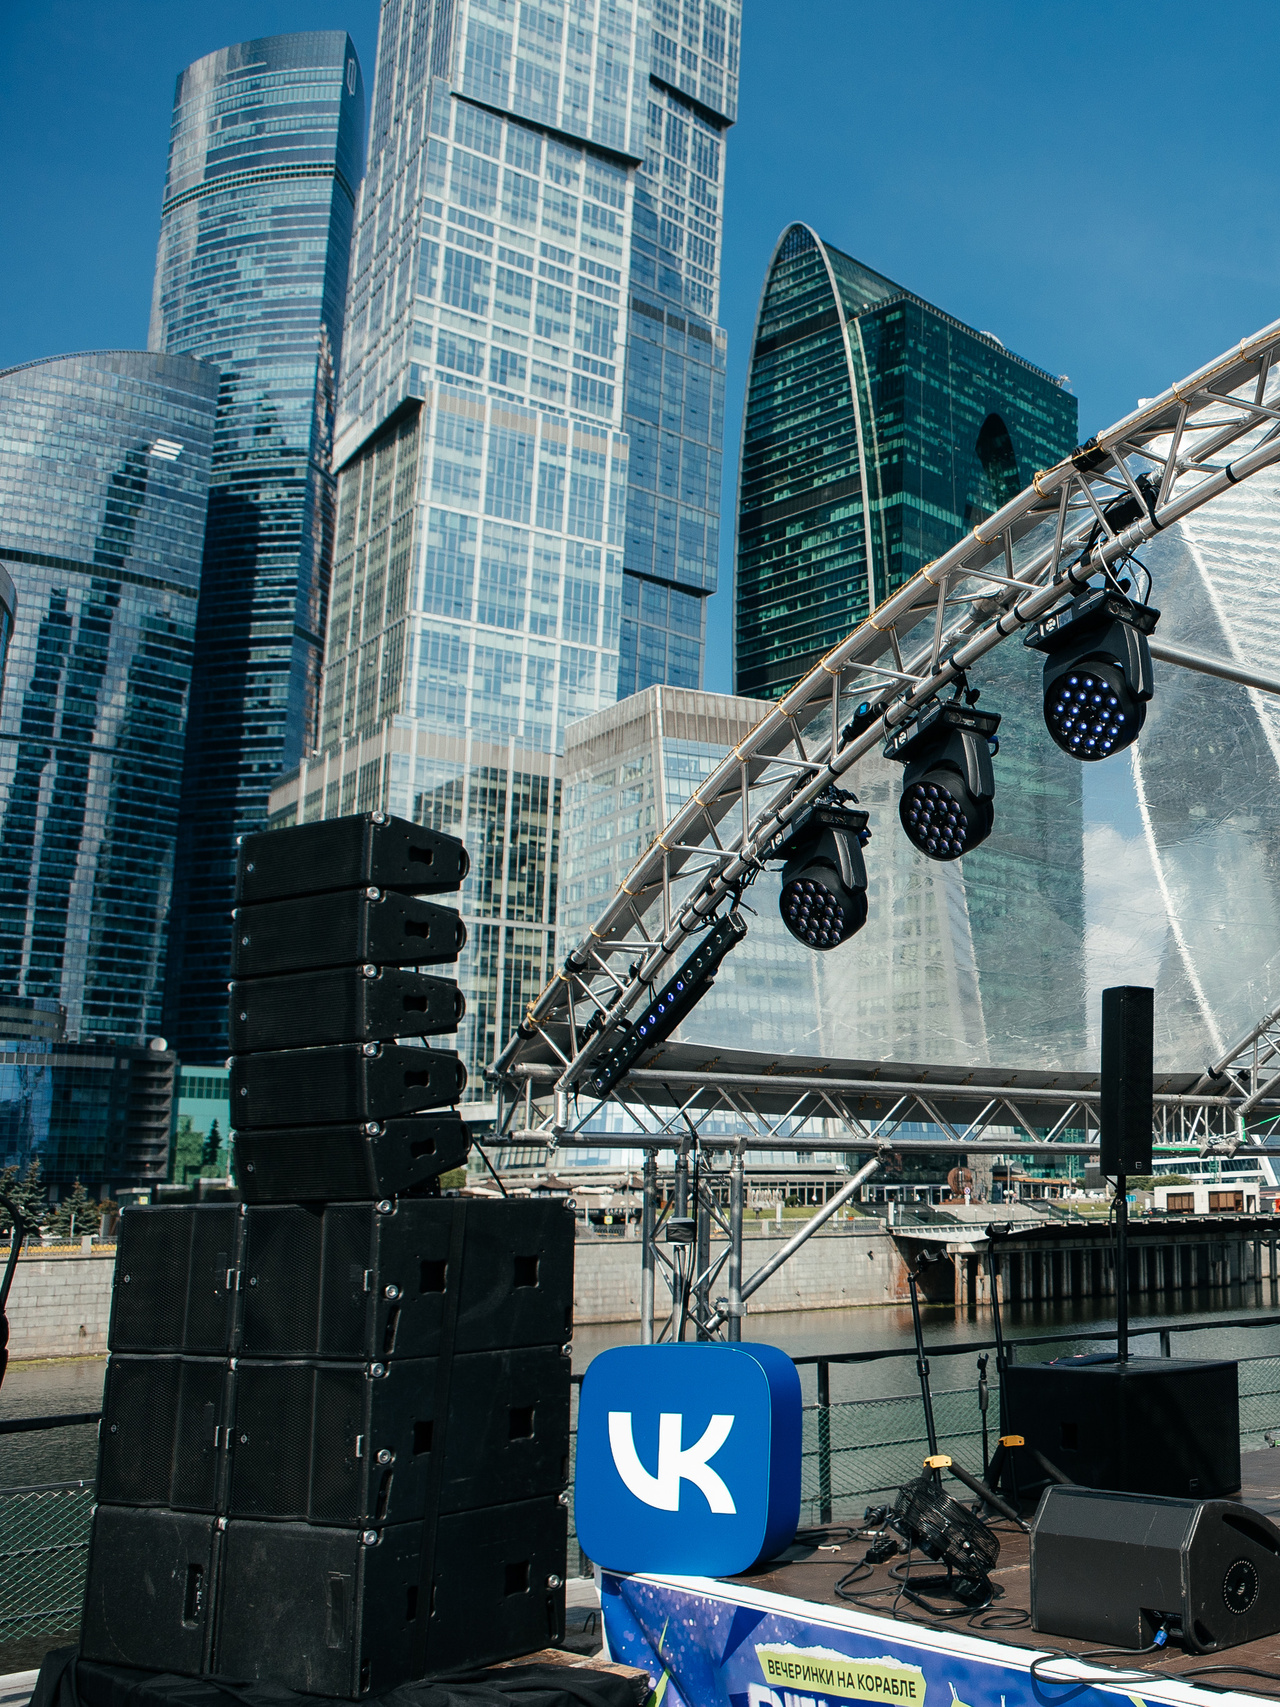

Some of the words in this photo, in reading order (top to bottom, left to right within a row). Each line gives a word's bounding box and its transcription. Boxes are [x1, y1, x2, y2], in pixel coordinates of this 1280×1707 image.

[608, 1411, 737, 1514] VK
[767, 1659, 834, 1686] ВЕЧЕРИНКИ
[837, 1671, 855, 1689] НА
[857, 1673, 917, 1699] КОРАБЛЕ
